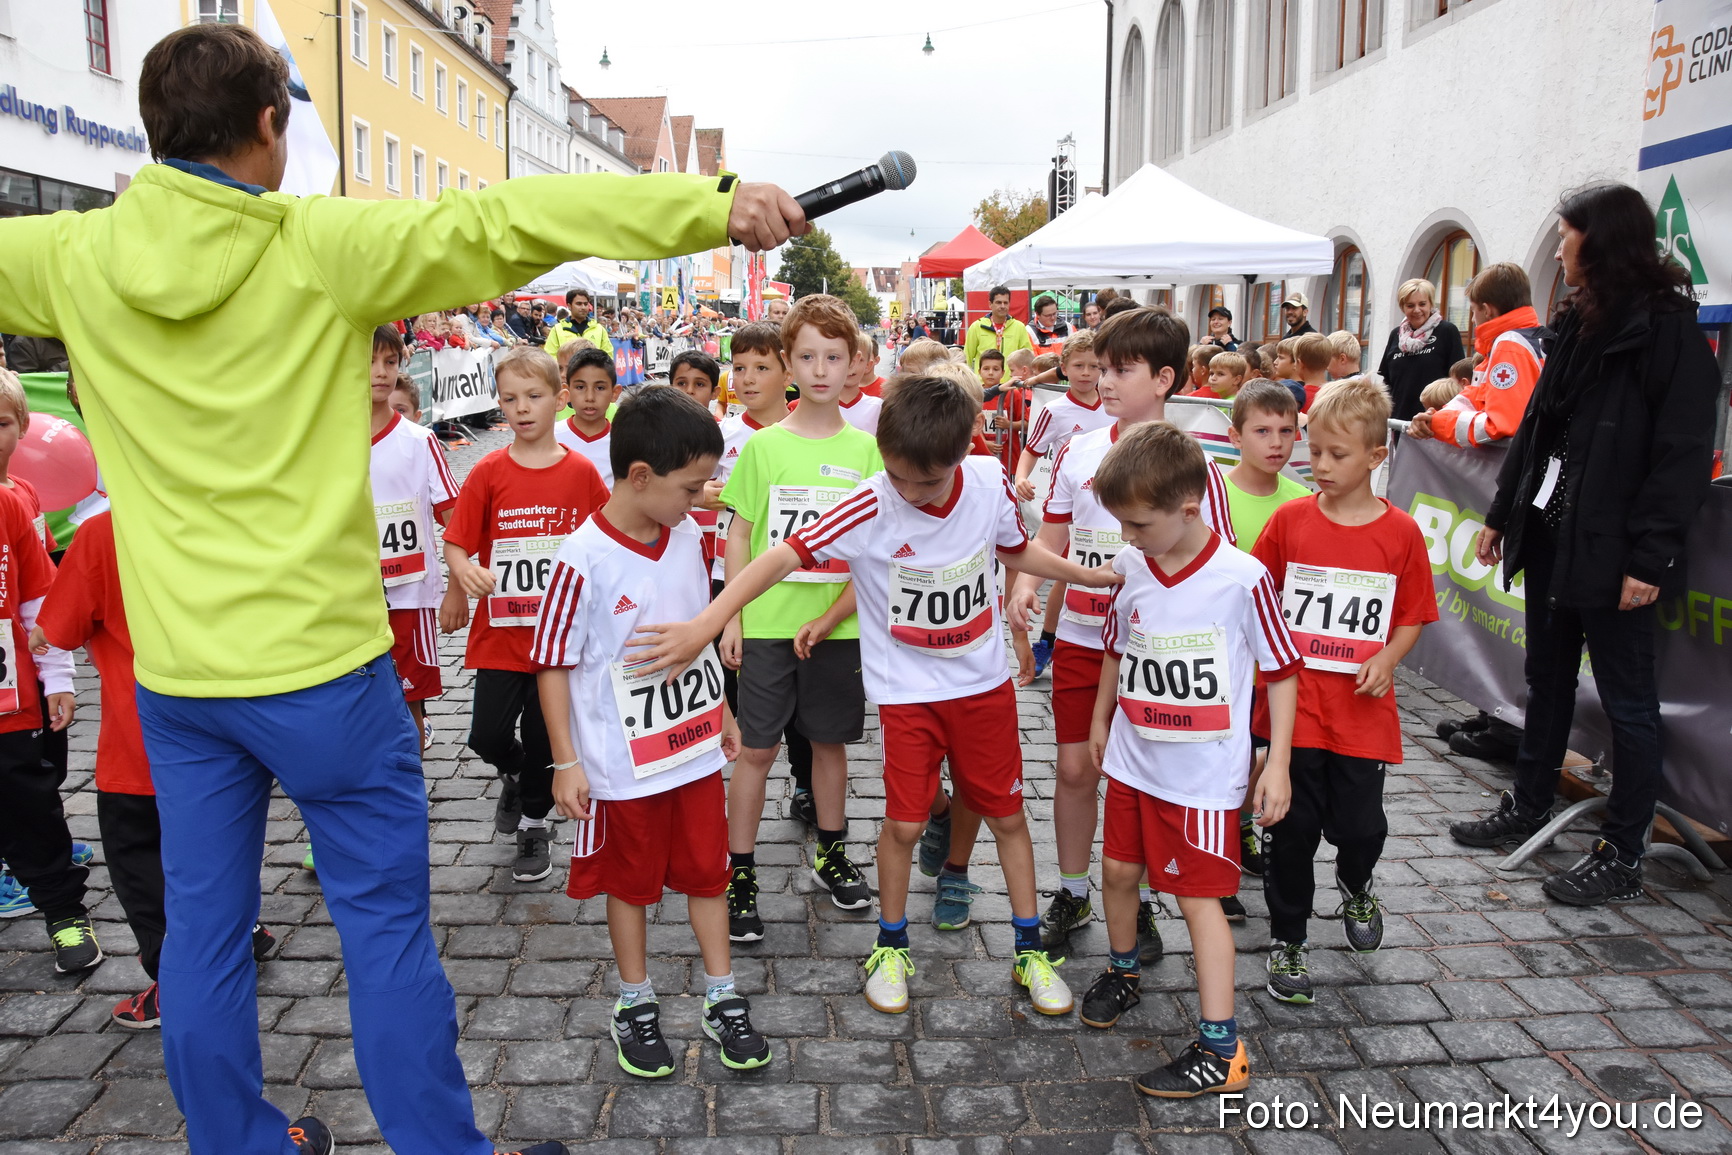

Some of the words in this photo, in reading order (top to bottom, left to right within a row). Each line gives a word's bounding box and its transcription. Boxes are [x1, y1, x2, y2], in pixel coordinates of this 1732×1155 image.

[64, 105, 146, 153] Rupprecht
[665, 294, 675, 305] A
[892, 306, 899, 314] A
[498, 505, 557, 518] Neumarkter
[498, 518, 545, 531] Stadtlauf
[382, 519, 418, 553] 49
[943, 549, 985, 581] BOCK
[898, 573, 935, 584] NeuerMarkt
[1334, 572, 1387, 589] BOCK
[901, 572, 987, 625] 7004
[613, 603, 638, 615] adidas
[1294, 588, 1383, 635] 7148
[1449, 591, 1471, 623] by
[1472, 606, 1511, 639] smart
[928, 629, 971, 647] Lukas
[1152, 633, 1215, 650] BOCK
[1310, 639, 1354, 659] Quirin
[1126, 652, 1218, 700] 7005
[630, 659, 721, 733] 7020
[1144, 707, 1192, 727] Simon
[667, 721, 712, 751] Ruben
